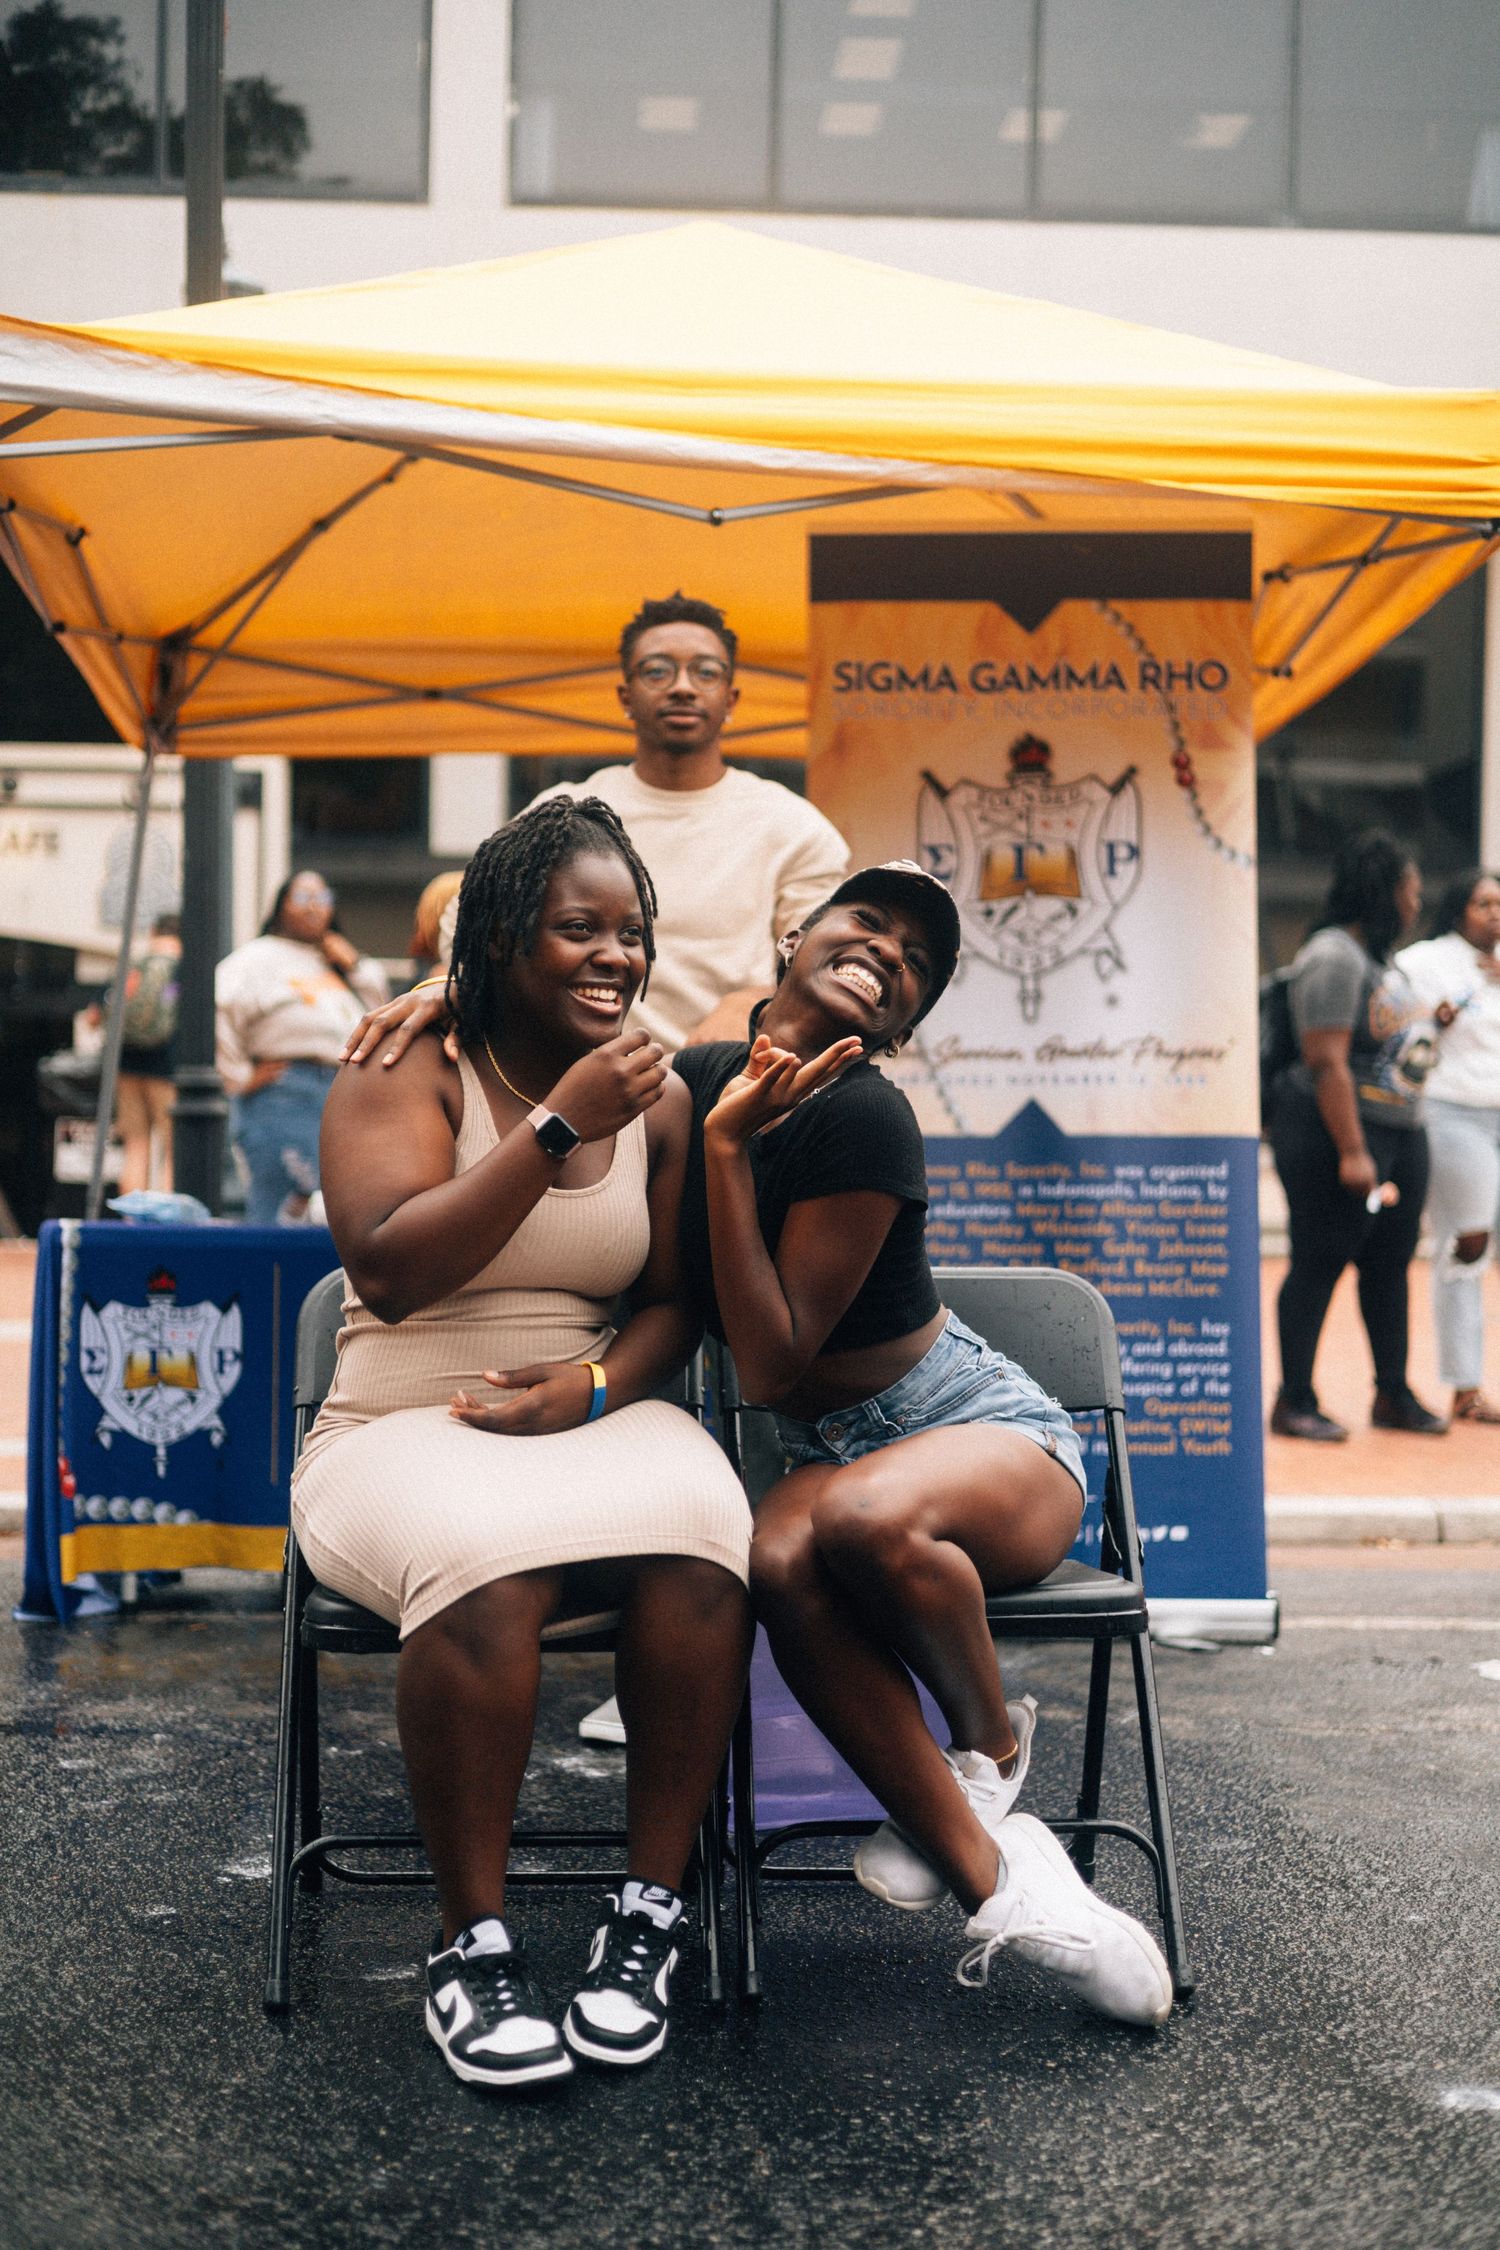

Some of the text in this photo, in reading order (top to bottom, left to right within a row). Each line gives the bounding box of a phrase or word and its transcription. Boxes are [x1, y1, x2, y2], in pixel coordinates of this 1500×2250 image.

[833, 660, 1229, 692] SIGMA GAMMA RHO
[1131, 1337, 1165, 1357] and
[649, 1885, 671, 1896] NIKE
